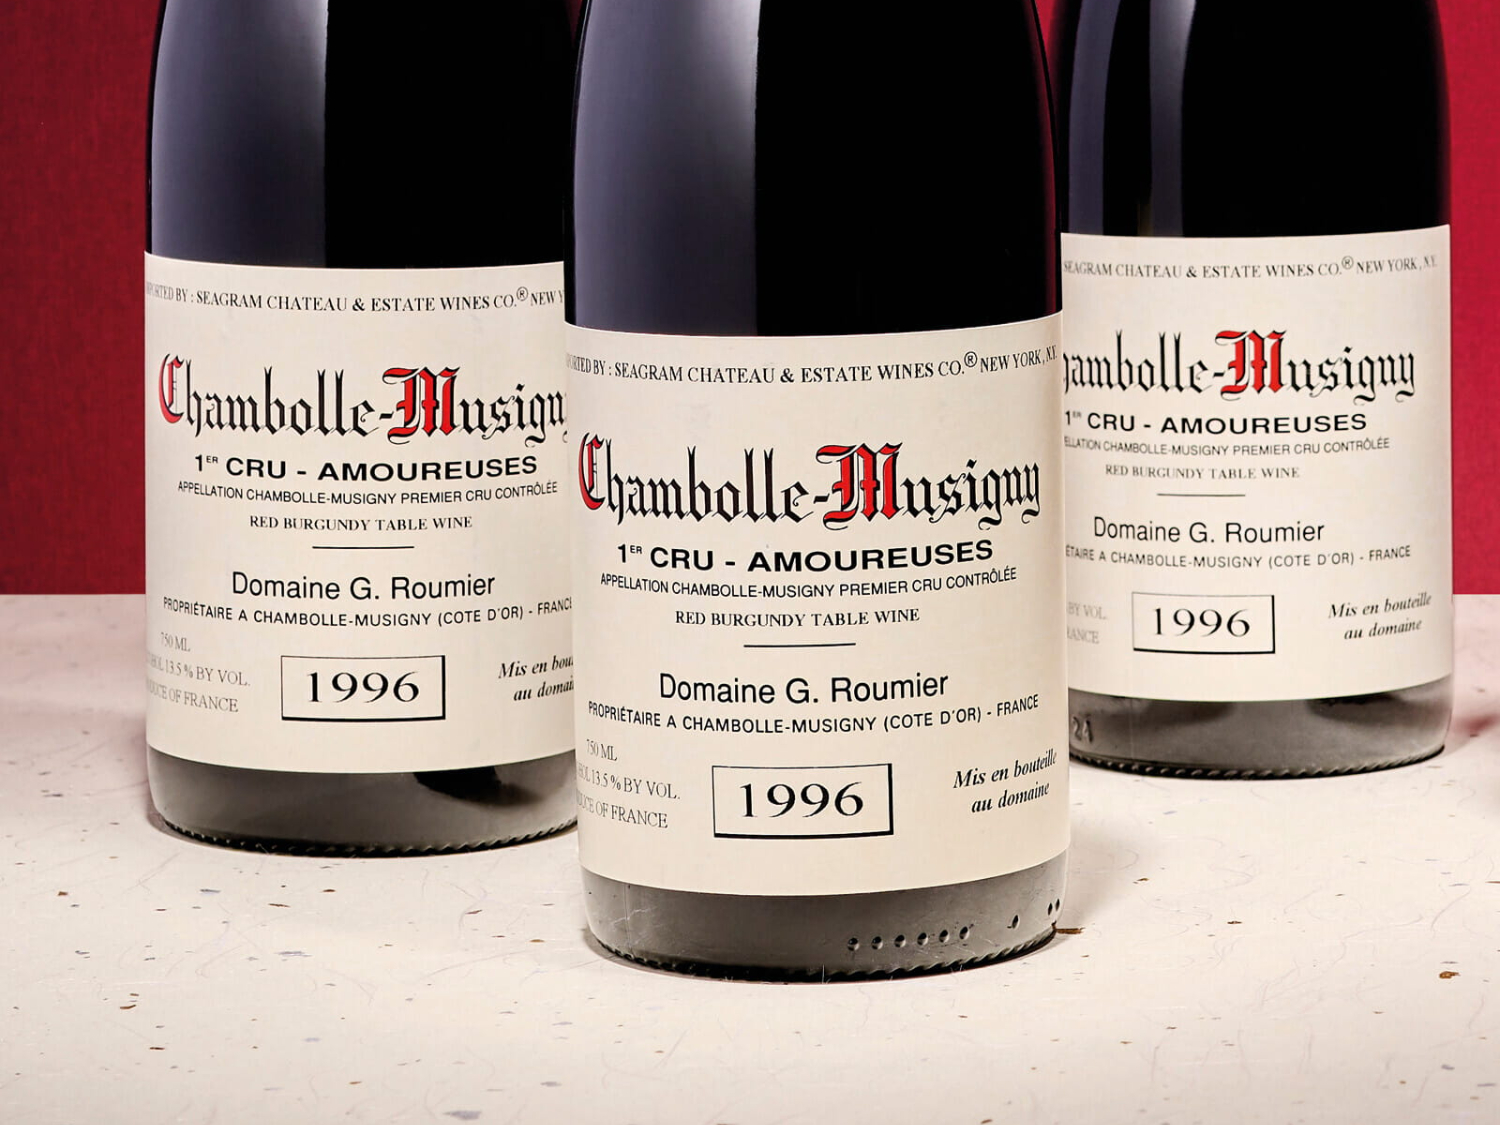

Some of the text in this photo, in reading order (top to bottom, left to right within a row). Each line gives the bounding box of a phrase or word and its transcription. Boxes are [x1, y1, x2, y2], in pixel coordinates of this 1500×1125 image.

[1114, 264, 1182, 278] CHATEAU
[1202, 266, 1260, 278] ESTATE
[1266, 264, 1314, 278] WINES
[1356, 260, 1382, 274] NEW
[196, 290, 262, 308] SEAGRAM
[266, 296, 346, 312] CHATEAU
[372, 298, 436, 312] ESTATE
[440, 296, 490, 310] WINES
[530, 290, 556, 306] NEW
[592, 354, 1010, 384] BY SEAGRAM CHATEAU & ESTATE WINES NEW
[1062, 330, 1414, 406] ambolle-Musigny
[158, 354, 568, 448] Chambolle-Musign
[1088, 412, 1366, 434] CRU AMOUREUSES
[1102, 436, 1390, 456] CHAMBOLLE-MUSIGNY PREMIER CRU CONTRÔLÉE
[226, 456, 538, 482] CRU AMOUREUSES
[578, 432, 1040, 530] Chambolle-Musigny
[1106, 464, 1300, 480] RED BURGUNDY TABLE WINE
[178, 480, 558, 504] APPELLATION CHAMBOLLE-MUSIGNY PREMIER CRU CONTRÔLÉE
[250, 516, 472, 530] RED BURGUNDY TABLE WINE
[1094, 516, 1324, 544] Domaine G. Roumier
[650, 538, 992, 572] CRU AMOUREUSES
[1110, 544, 1410, 570] CHAMBOLLE-MUSIGNY (COTE FRANCE
[232, 570, 496, 600] Domaine G. Roumier
[600, 564, 1016, 598] APPELLATION CHAMBOLLE-MUSIGNY PREMIER CRU CONTRÔLÉE
[164, 596, 232, 620] PROPRIÉTAIRE
[254, 610, 432, 626] CHAMBOLLE-MUSIGNY
[438, 610, 482, 628] (COTE
[676, 608, 920, 628] RED BURGUNDY TABLE WINE
[1328, 590, 1432, 618] Mis en bouteille
[1156, 608, 1250, 636] 1996
[1344, 618, 1422, 640] au domaine
[196, 666, 250, 686] BY VOL.
[498, 660, 548, 678] Mis en
[184, 690, 238, 712] FRANCE
[306, 672, 420, 704] 1996
[514, 688, 532, 702] au
[660, 672, 948, 704] Domaine G. Roumier
[588, 700, 662, 728] PROPRIÉTAIRE
[682, 716, 876, 734] CHAMBOLLE-MUSIGNY
[884, 712, 934, 732] (COTE
[996, 694, 1038, 716] FRANCE
[600, 744, 618, 762] ML
[952, 748, 1056, 788] Mis en bouteille
[624, 776, 680, 800] BY VOL.
[740, 782, 864, 818] 1996
[972, 782, 1050, 814] au domaine
[596, 800, 608, 818] OF
[610, 804, 668, 828] FRANCE
